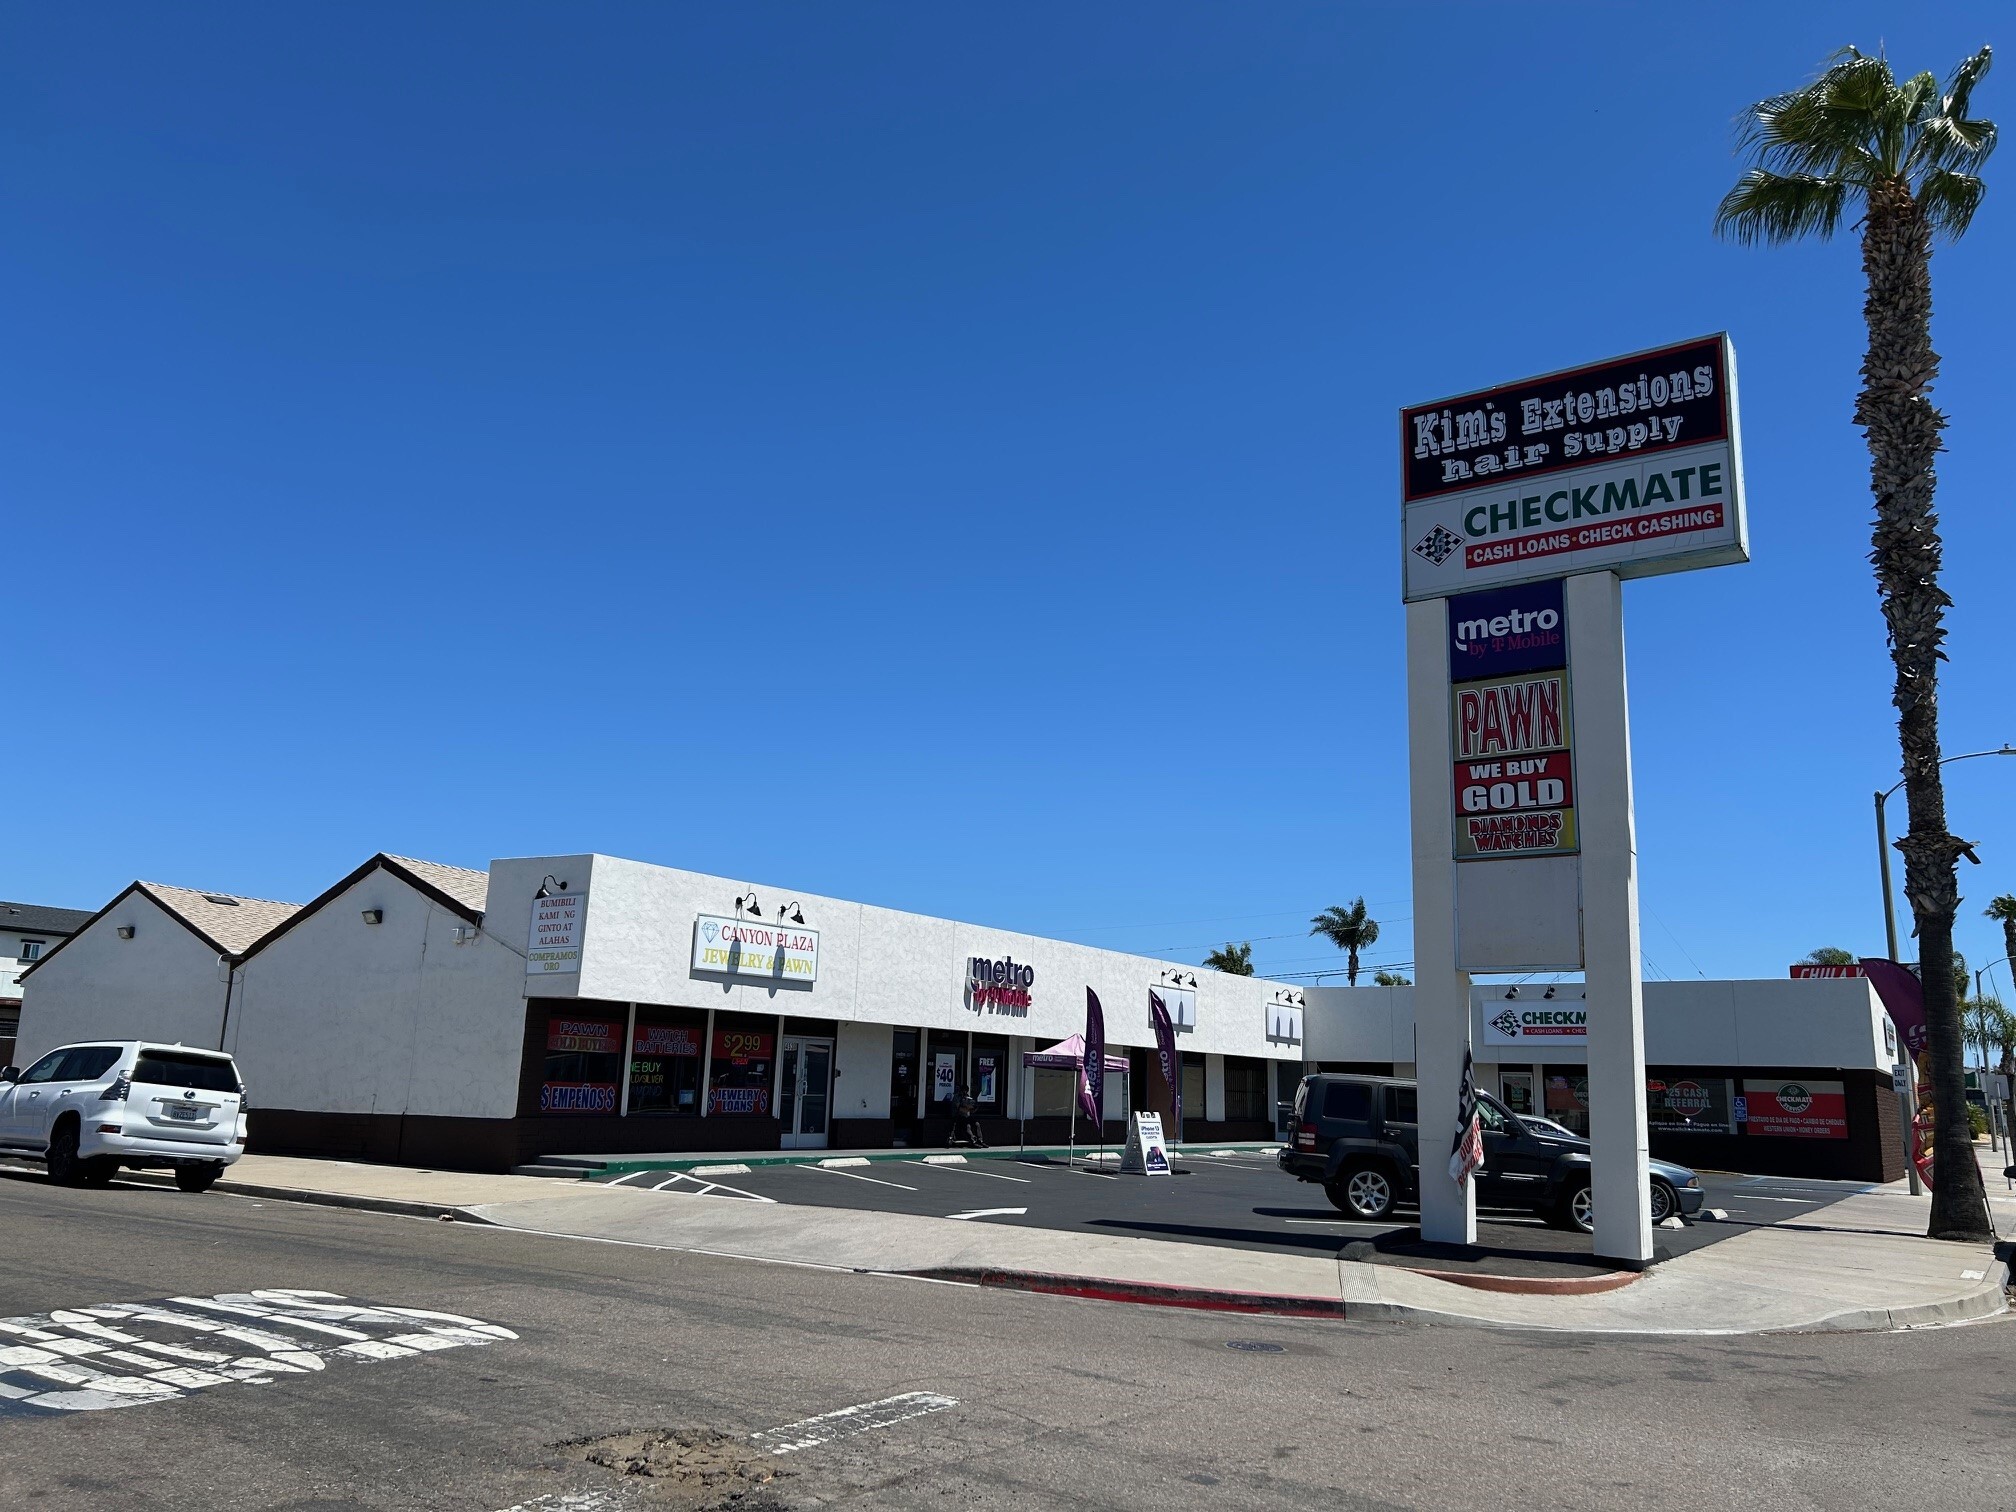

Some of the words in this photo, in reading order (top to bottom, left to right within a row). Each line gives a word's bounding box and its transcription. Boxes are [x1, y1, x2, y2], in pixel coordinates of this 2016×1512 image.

[1413, 402, 1507, 459] Kim's
[1521, 365, 1714, 435] Extensions
[1563, 415, 1683, 457] Supply
[1464, 463, 1722, 537] CHECKMATE
[1473, 545, 1514, 563] CASH
[1518, 534, 1571, 555] LOANS
[1579, 524, 1634, 545] CHECK
[1637, 510, 1716, 535] CASHING
[1456, 608, 1558, 650] metro
[1467, 641, 1487, 659] by
[1457, 678, 1564, 758] PAWN
[1470, 762, 1502, 780] WE
[1507, 758, 1548, 777] BUY
[1462, 778, 1564, 812] GOLD
[1467, 811, 1563, 838] DIAMONDS
[1474, 830, 1558, 853] WATCHES
[540, 897, 576, 908] BUMIBILI
[538, 911, 560, 921] KAMI
[564, 910, 576, 920] NG
[537, 923, 561, 933] GINTO
[563, 922, 574, 932] AT
[539, 935, 570, 946] ALAHAS
[721, 924, 773, 947] CANYON
[777, 933, 815, 952] PLAZA
[528, 950, 578, 962] COMPRAMOS
[702, 947, 765, 970] JEWELRY
[766, 957, 775, 970] &
[778, 958, 813, 975] PAWN
[543, 961, 561, 971] ORO
[971, 955, 1034, 992] metro
[1521, 1011, 1587, 1025] CHECKM
[559, 1021, 610, 1037] PAWN
[647, 1028, 689, 1043] WATCH
[635, 1040, 697, 1056] BATTERIES
[979, 1057, 995, 1067] FREE
[1032, 1054, 1053, 1064] metro
[630, 1062, 640, 1073] E
[641, 1062, 662, 1073] BUY
[936, 1068, 953, 1082] $40
[1894, 1069, 1905, 1077] EXIT
[716, 1086, 759, 1102] JEWELRY
[1683, 1088, 1709, 1098] CASH
[721, 1099, 753, 1113] LOANS
[1664, 1098, 1712, 1108] REFERRAL
